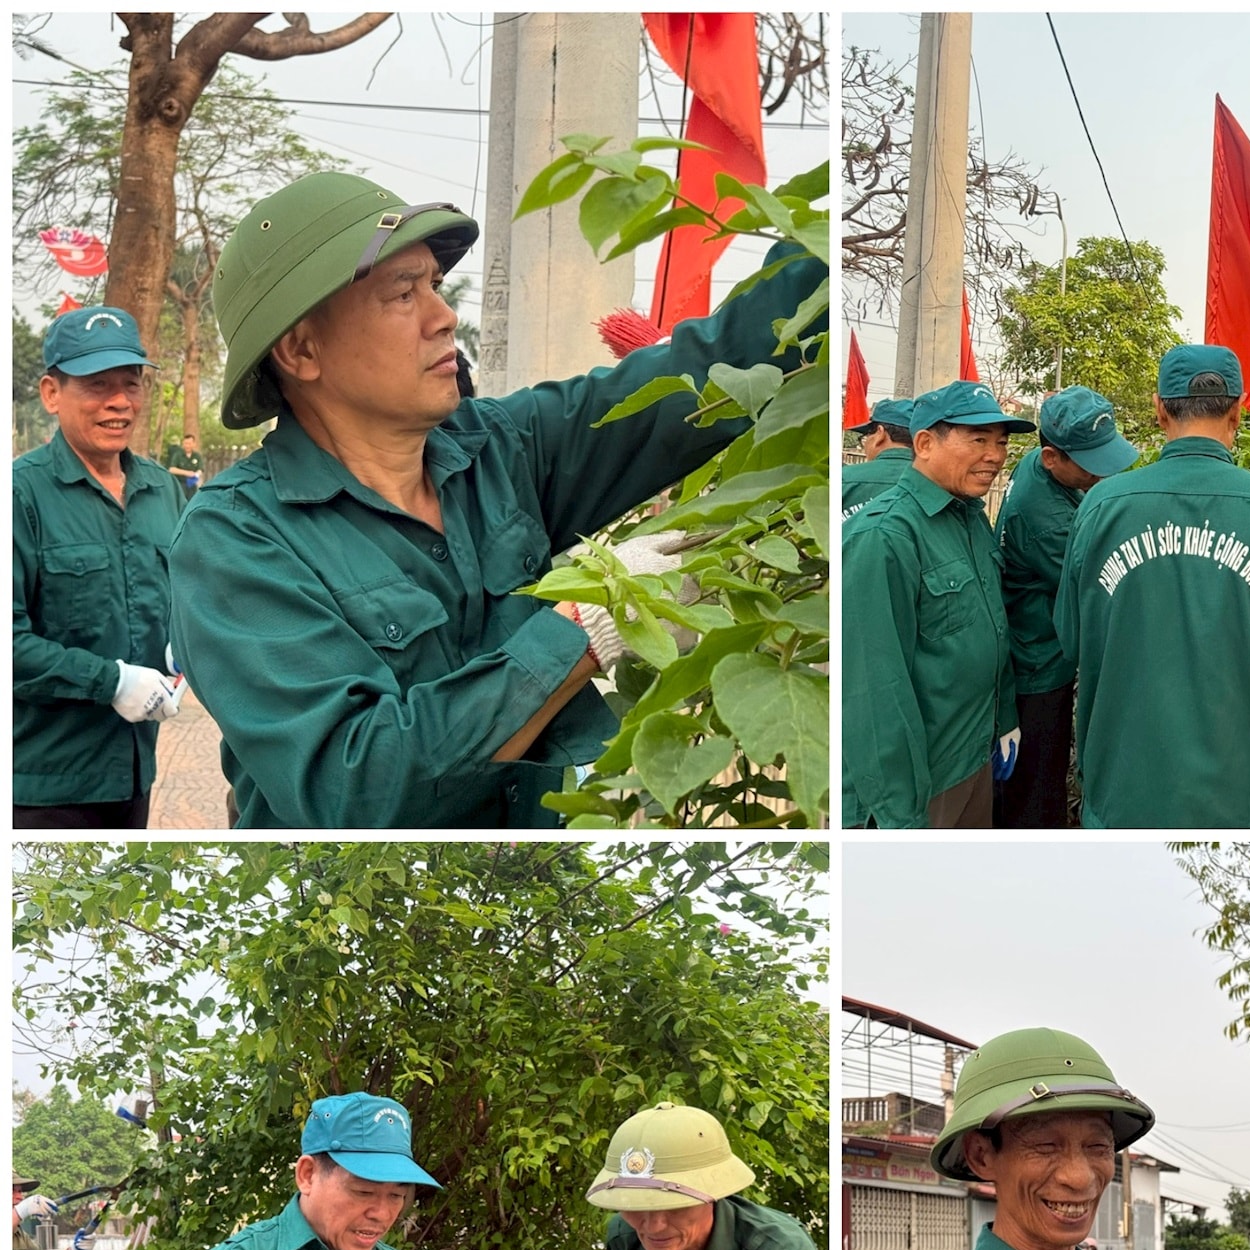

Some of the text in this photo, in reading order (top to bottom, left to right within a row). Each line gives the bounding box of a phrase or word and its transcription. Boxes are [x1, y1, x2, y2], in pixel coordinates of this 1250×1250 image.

[1098, 551, 1128, 596] CHUNG
[1119, 536, 1144, 569] TAY
[1141, 524, 1157, 559] VÌ
[1157, 520, 1181, 556] SỨC
[1184, 519, 1216, 558] KHỎE
[1213, 531, 1250, 573] CỘNG
